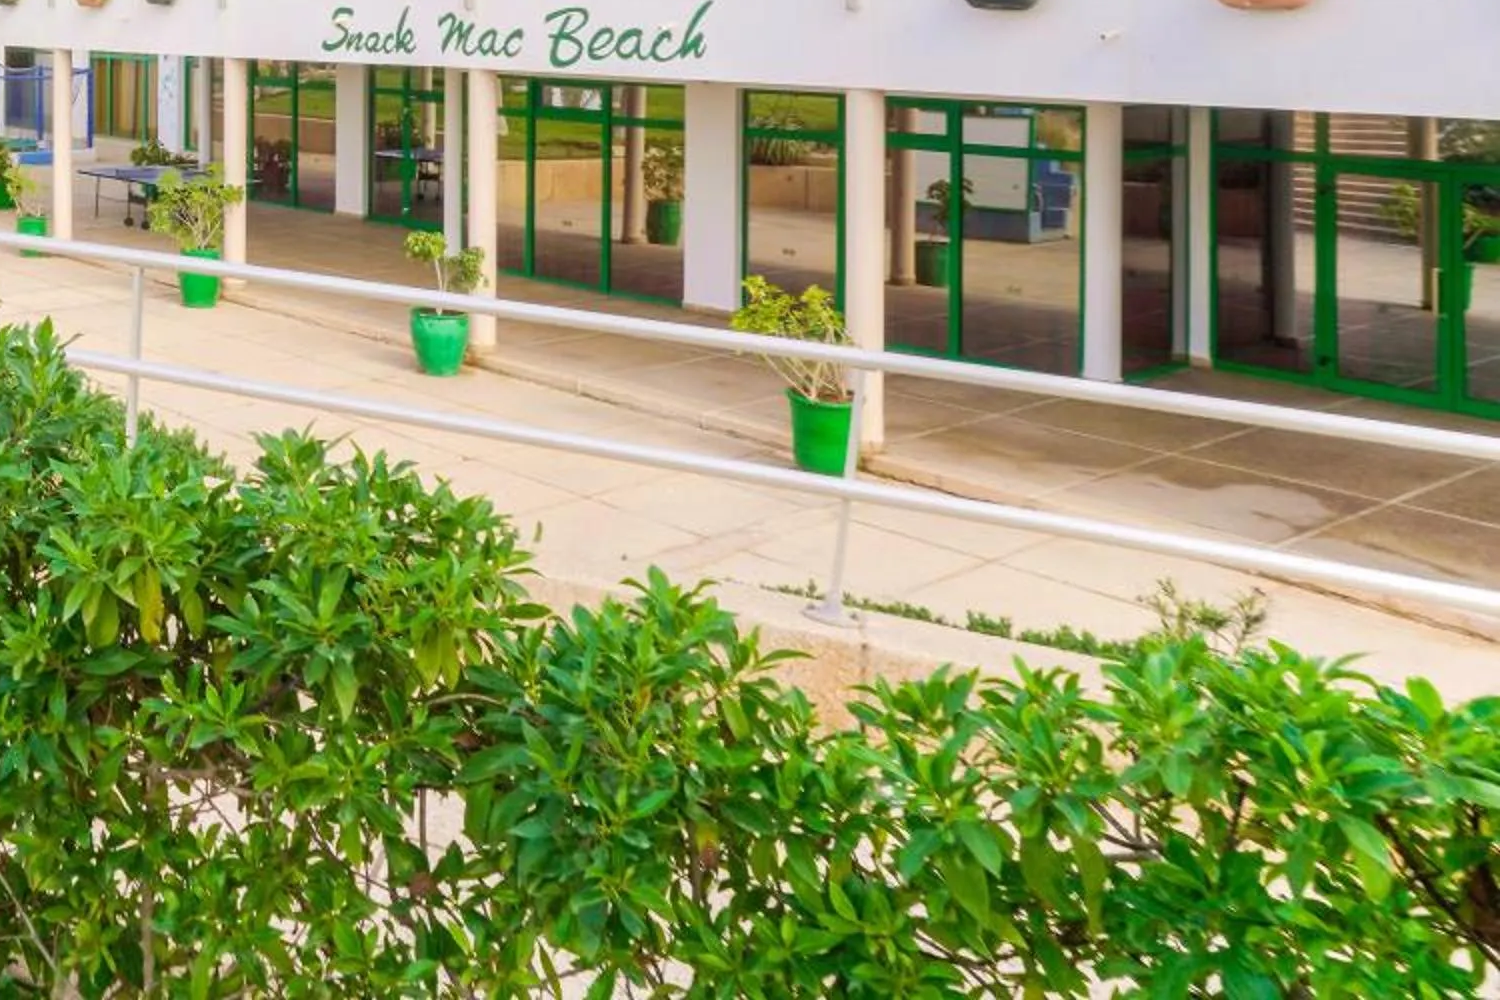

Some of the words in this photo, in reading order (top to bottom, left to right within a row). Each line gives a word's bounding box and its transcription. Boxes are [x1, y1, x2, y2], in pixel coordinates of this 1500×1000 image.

[322, 5, 416, 54] Snack
[437, 11, 524, 58] Mac
[544, 0, 714, 68] Beach
